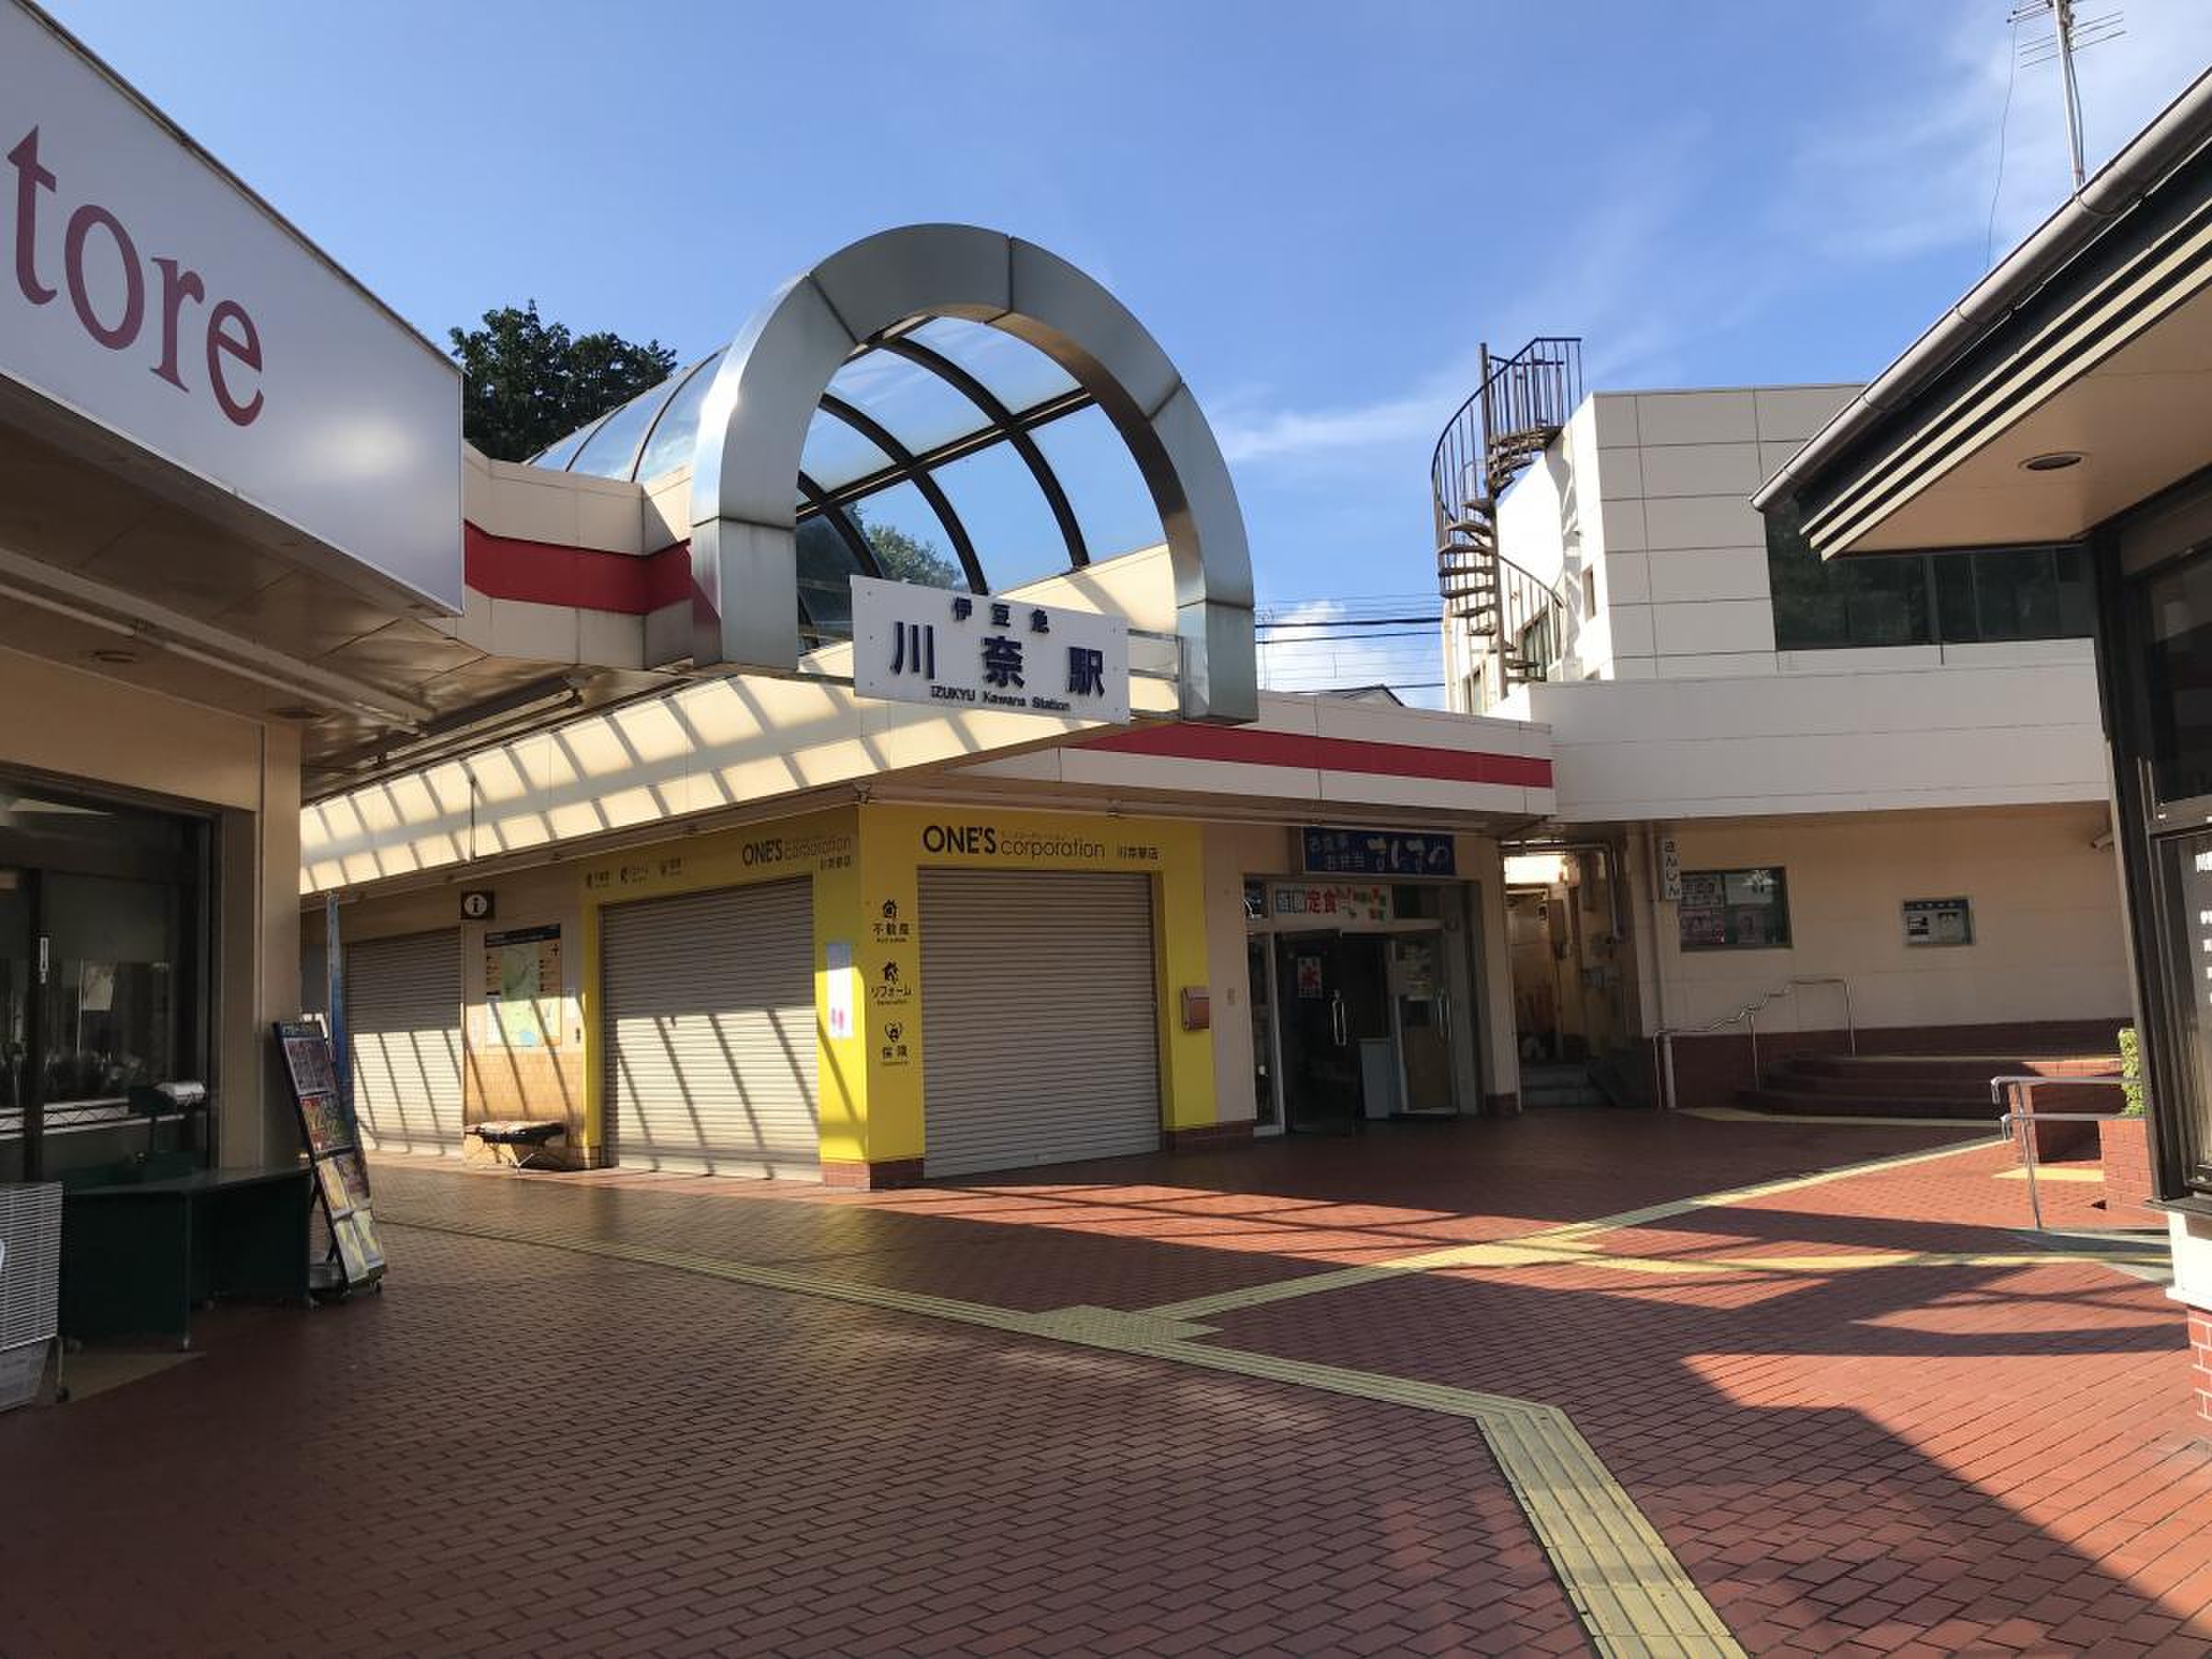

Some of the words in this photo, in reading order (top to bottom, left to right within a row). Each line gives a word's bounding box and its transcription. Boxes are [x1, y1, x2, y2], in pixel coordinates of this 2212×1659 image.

[7, 124, 265, 426] tore
[953, 596, 1050, 633] 伊豆急
[890, 620, 1105, 697] 川奈駅
[931, 685, 976, 701] IZUKYU
[982, 692, 1026, 708] Kawana
[1032, 695, 1071, 712] Station
[922, 825, 996, 854] ONE'S
[1001, 837, 1106, 859] corporation
[871, 984, 912, 998] リフォーム
